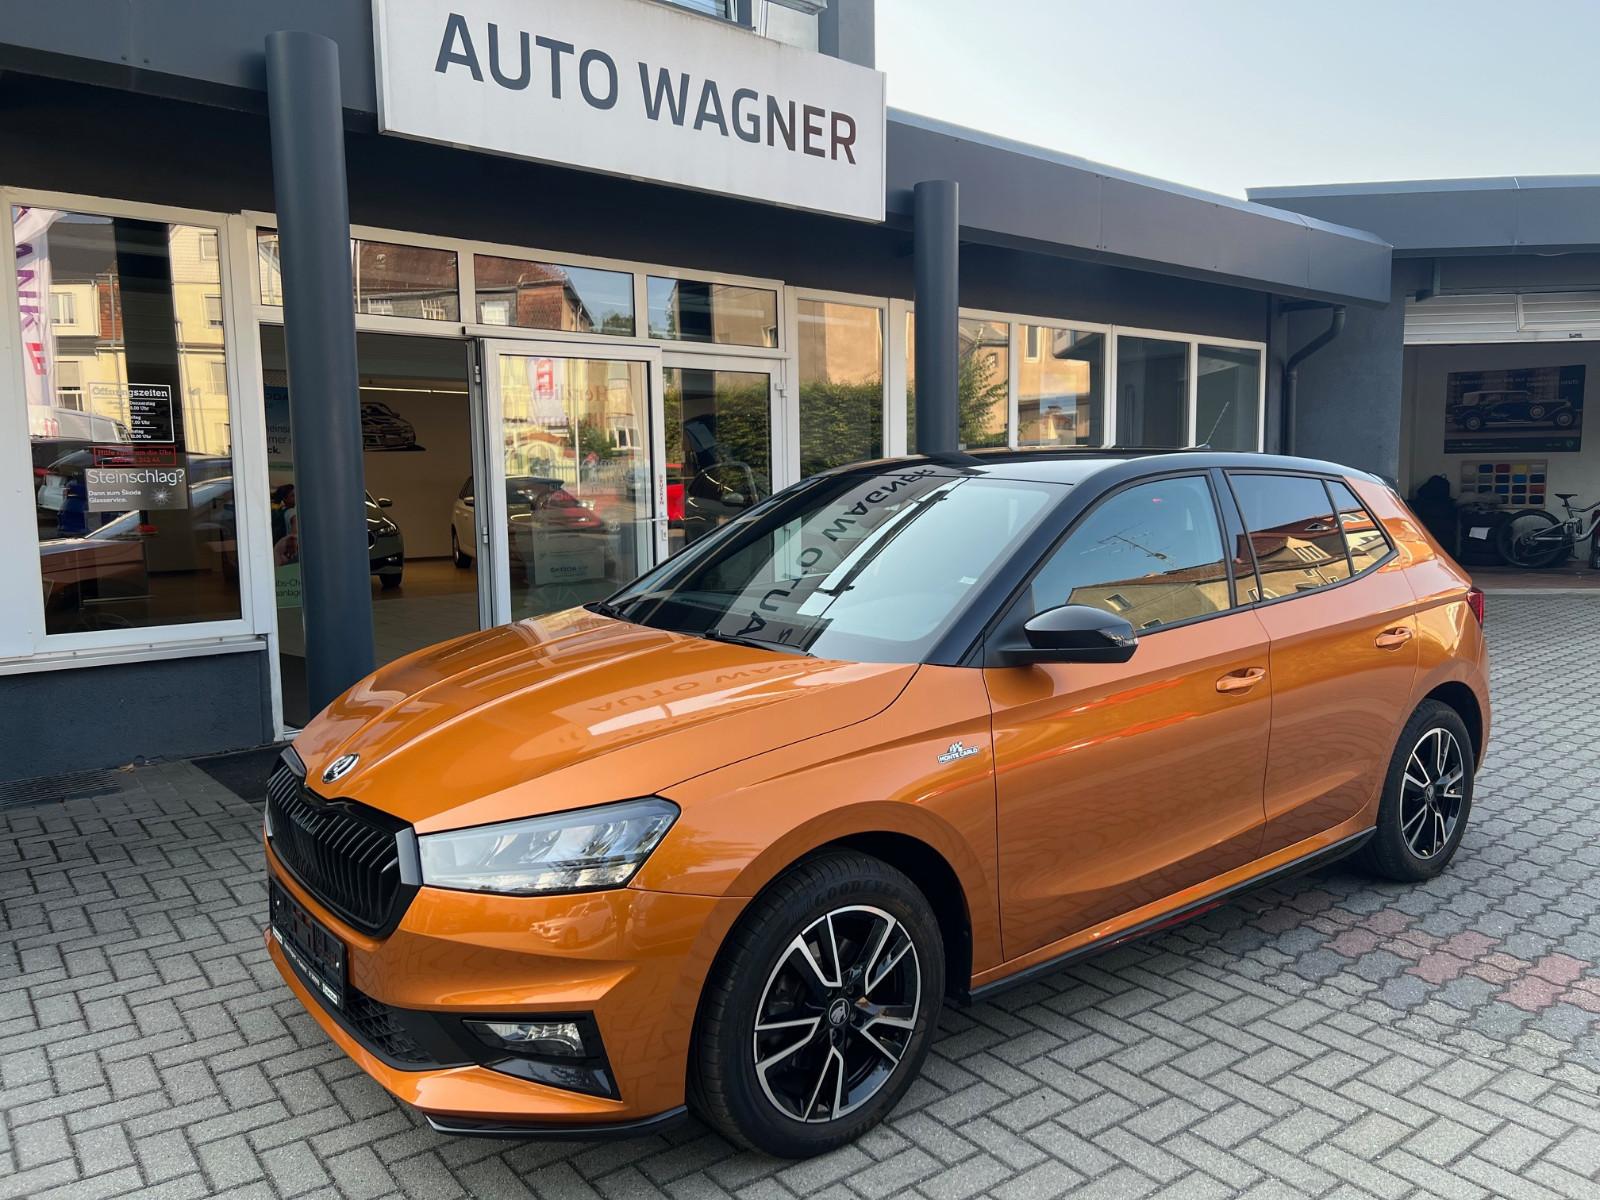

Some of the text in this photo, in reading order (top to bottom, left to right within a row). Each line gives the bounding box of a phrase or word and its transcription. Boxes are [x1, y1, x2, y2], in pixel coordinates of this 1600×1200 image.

[434, 12, 857, 165] AUTO WAGNER
[87, 468, 185, 486] Steinschlag?
